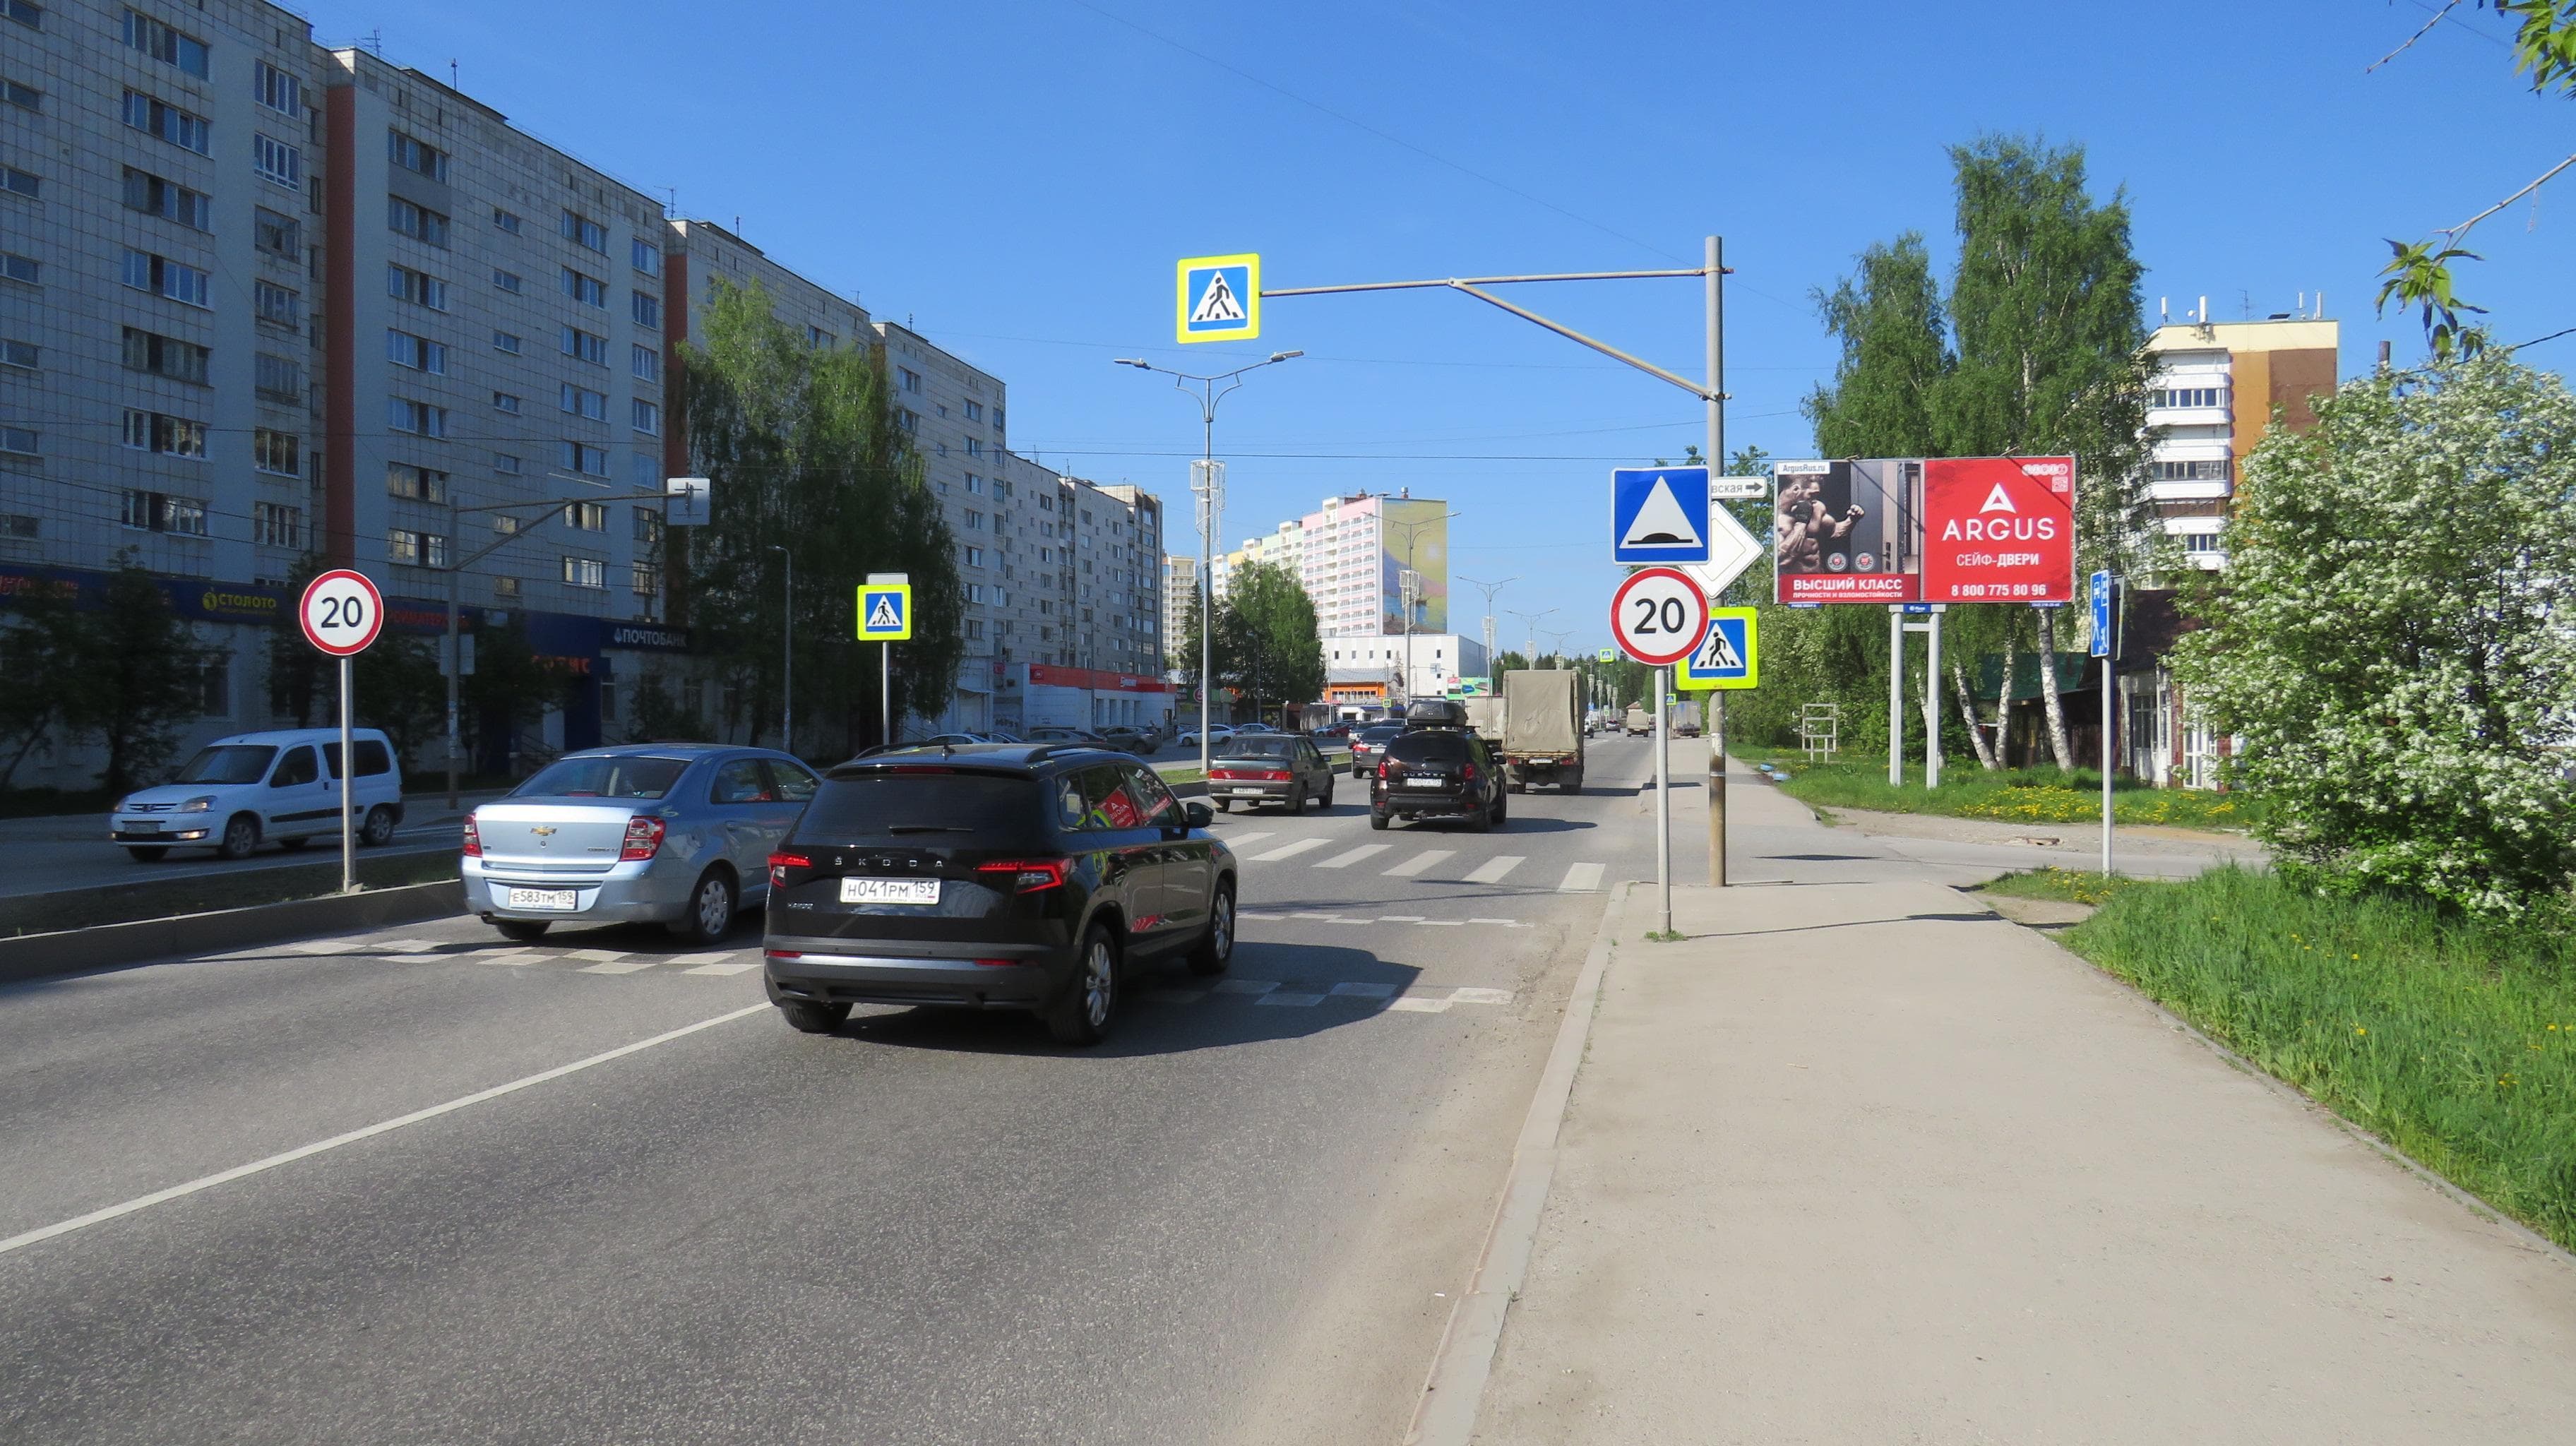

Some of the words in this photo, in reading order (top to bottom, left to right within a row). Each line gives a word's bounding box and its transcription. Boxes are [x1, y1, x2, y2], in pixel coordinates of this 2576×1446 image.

[1783, 464, 1825, 472] ArgusRus.ru
[1942, 517, 2056, 542] ARGUS
[1956, 552, 2039, 568] СЕЙФ-ДВЕРИ
[1793, 577, 1854, 591] ВЫСШИЙ
[1859, 578, 1903, 591] КЛАСС
[1951, 584, 1959, 597] 8
[1962, 584, 1985, 597] 800
[1988, 584, 2010, 597] 775
[2012, 584, 2027, 596] 80
[2031, 584, 2046, 596] 96
[218, 593, 277, 609] СТОЛОТО
[321, 596, 363, 628] 20
[1634, 597, 1685, 635] 20
[912, 880, 935, 894] 159
